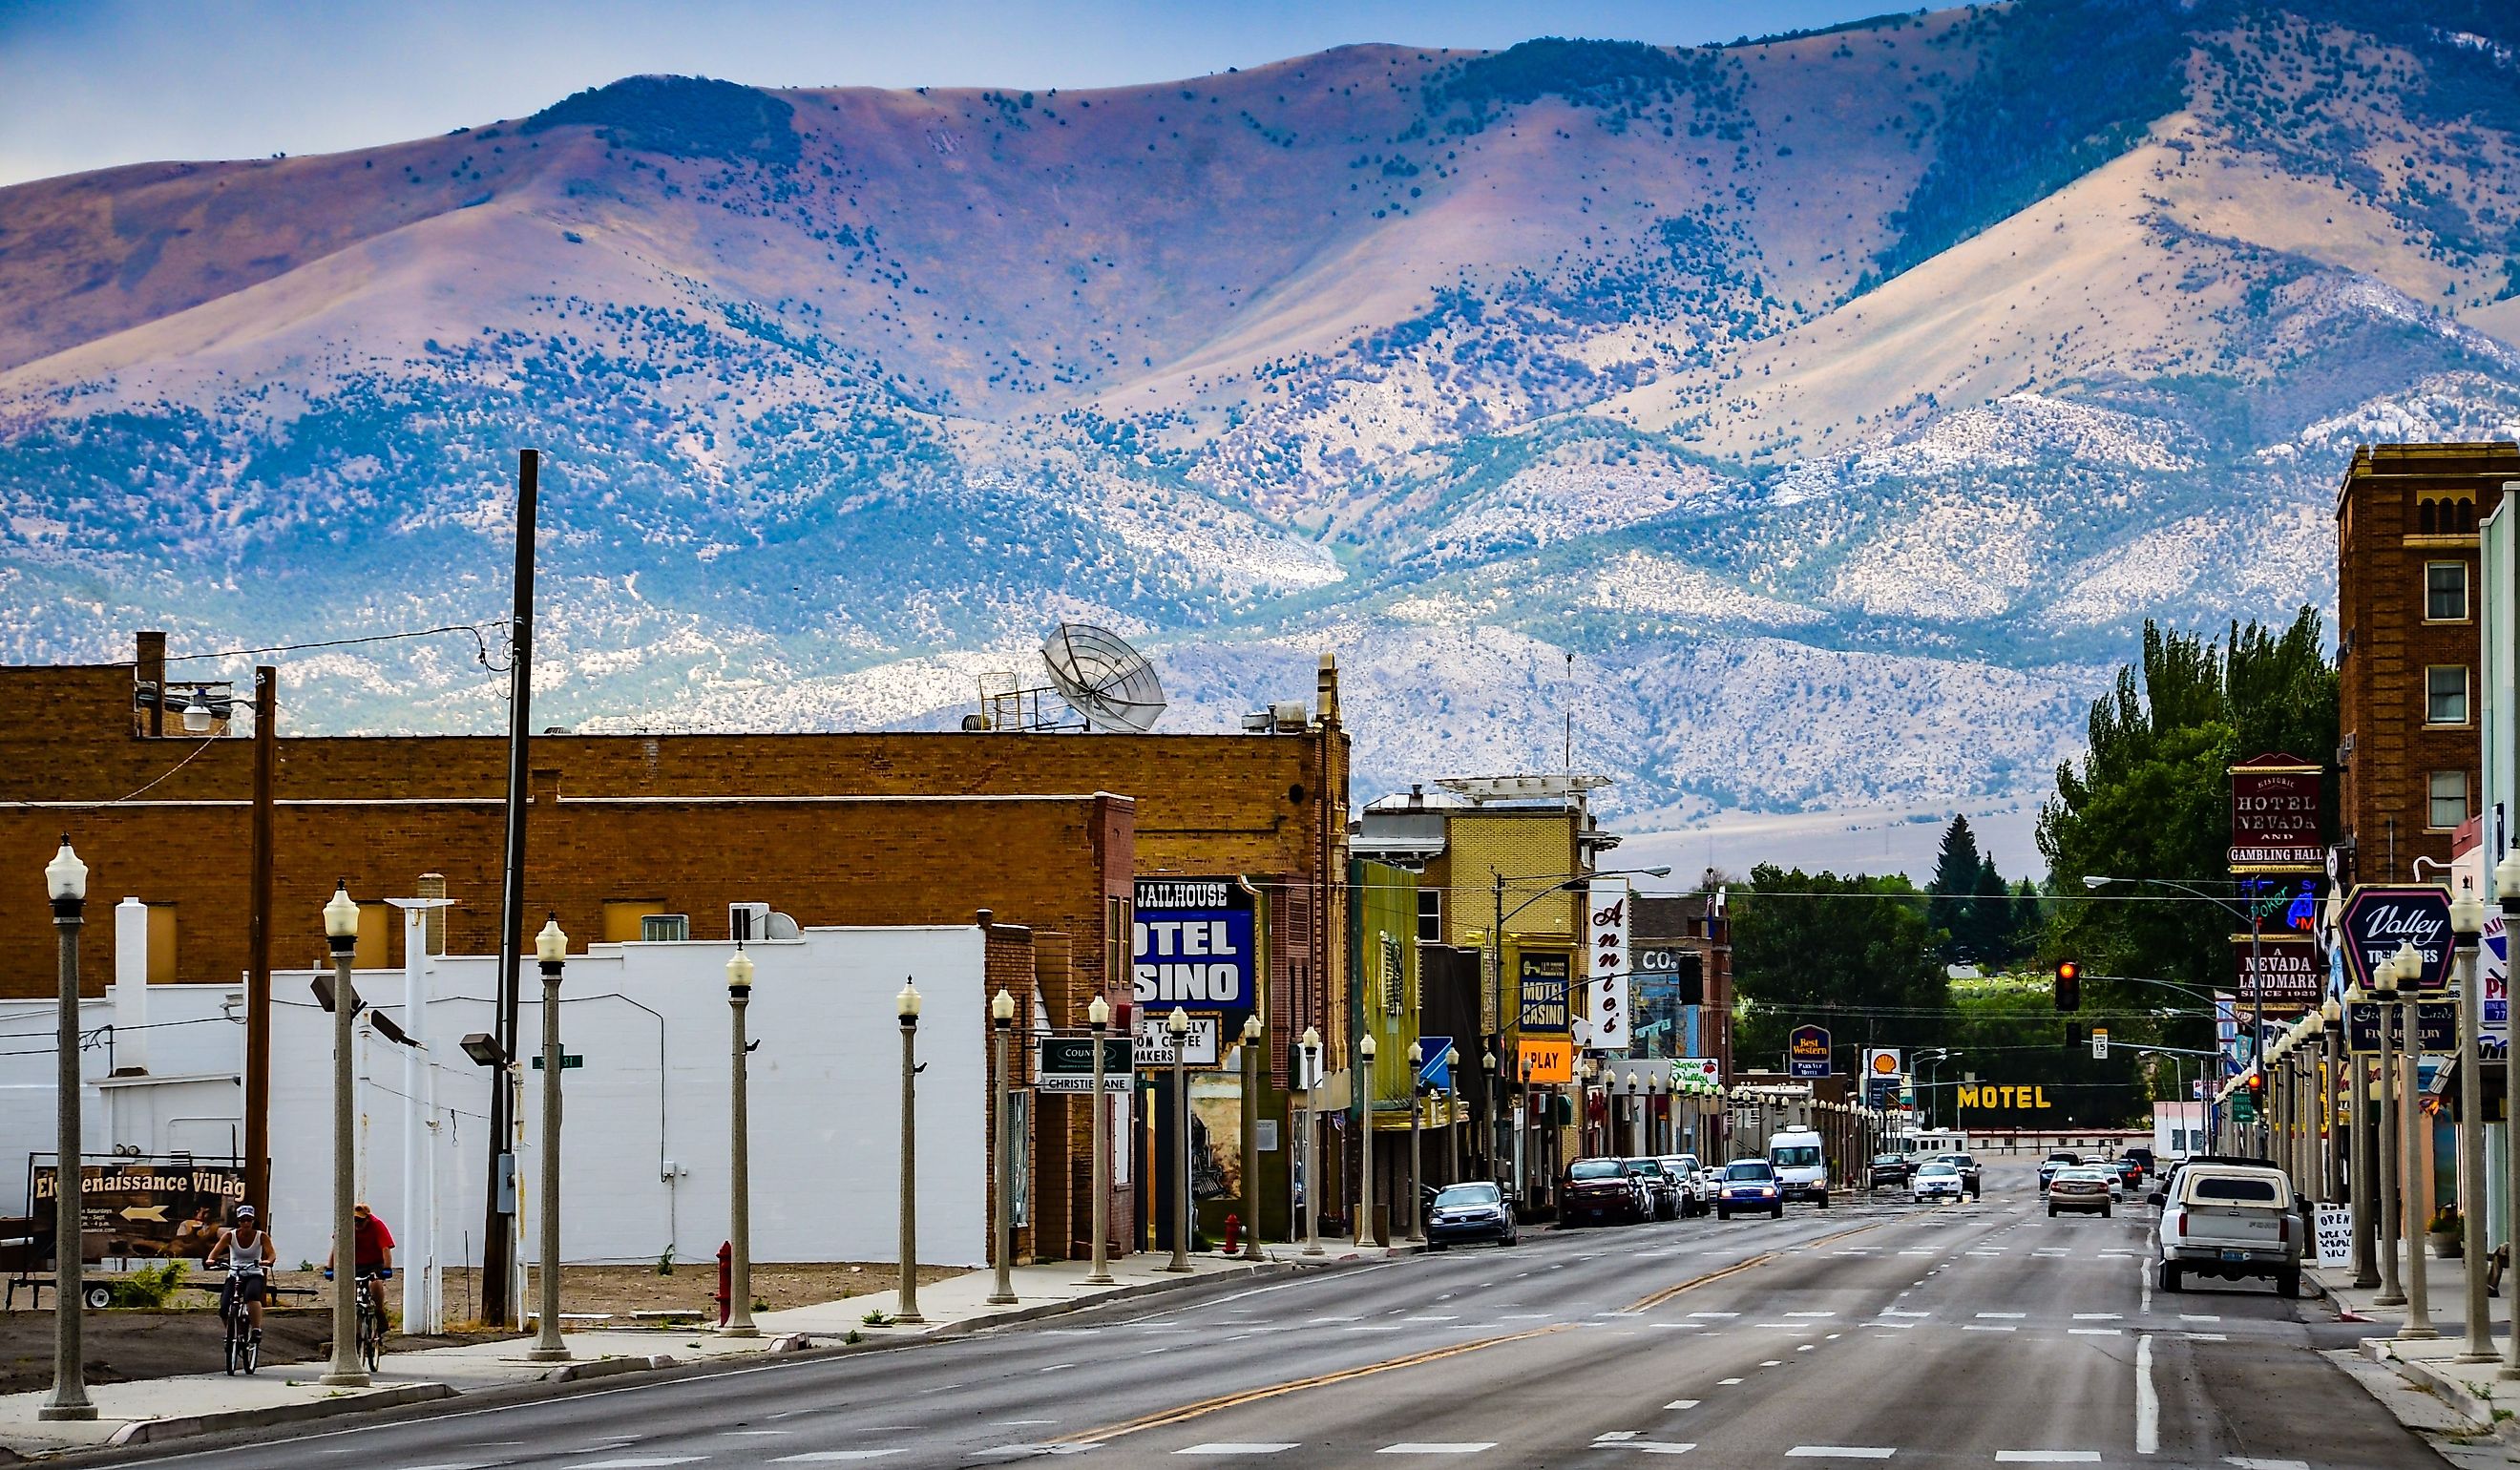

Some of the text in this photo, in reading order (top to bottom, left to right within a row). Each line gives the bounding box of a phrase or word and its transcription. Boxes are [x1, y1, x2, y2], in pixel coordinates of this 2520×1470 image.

[2237, 796, 2317, 810] HOTEL
[2237, 816, 2317, 830] NEVADA
[2231, 849, 2323, 861] GAMBLING HALL
[1137, 884, 1228, 908] JAILHOUSE
[2365, 904, 2445, 947] Valley
[1592, 898, 1625, 1034] Annie's
[1642, 951, 1678, 970] CO.
[2245, 957, 2312, 972] NEVADA
[2238, 974, 2318, 989] LANDMARK
[1522, 981, 1564, 1001] MOTEL
[1522, 1004, 1564, 1026] CASINO
[1134, 1036, 1154, 1048] OM
[1799, 1038, 1818, 1047] Best
[2095, 1043, 2106, 1052] 15
[1065, 1048, 1107, 1058] COUNTY
[1793, 1045, 1827, 1055] Western
[1530, 1052, 1559, 1069] PLAY
[1103, 1079, 1125, 1089] ANE
[1958, 1085, 2051, 1109] MOTEL
[81, 1171, 187, 1192] enaissance
[192, 1171, 246, 1202] Villag
[2320, 1213, 2350, 1227] OPEN
